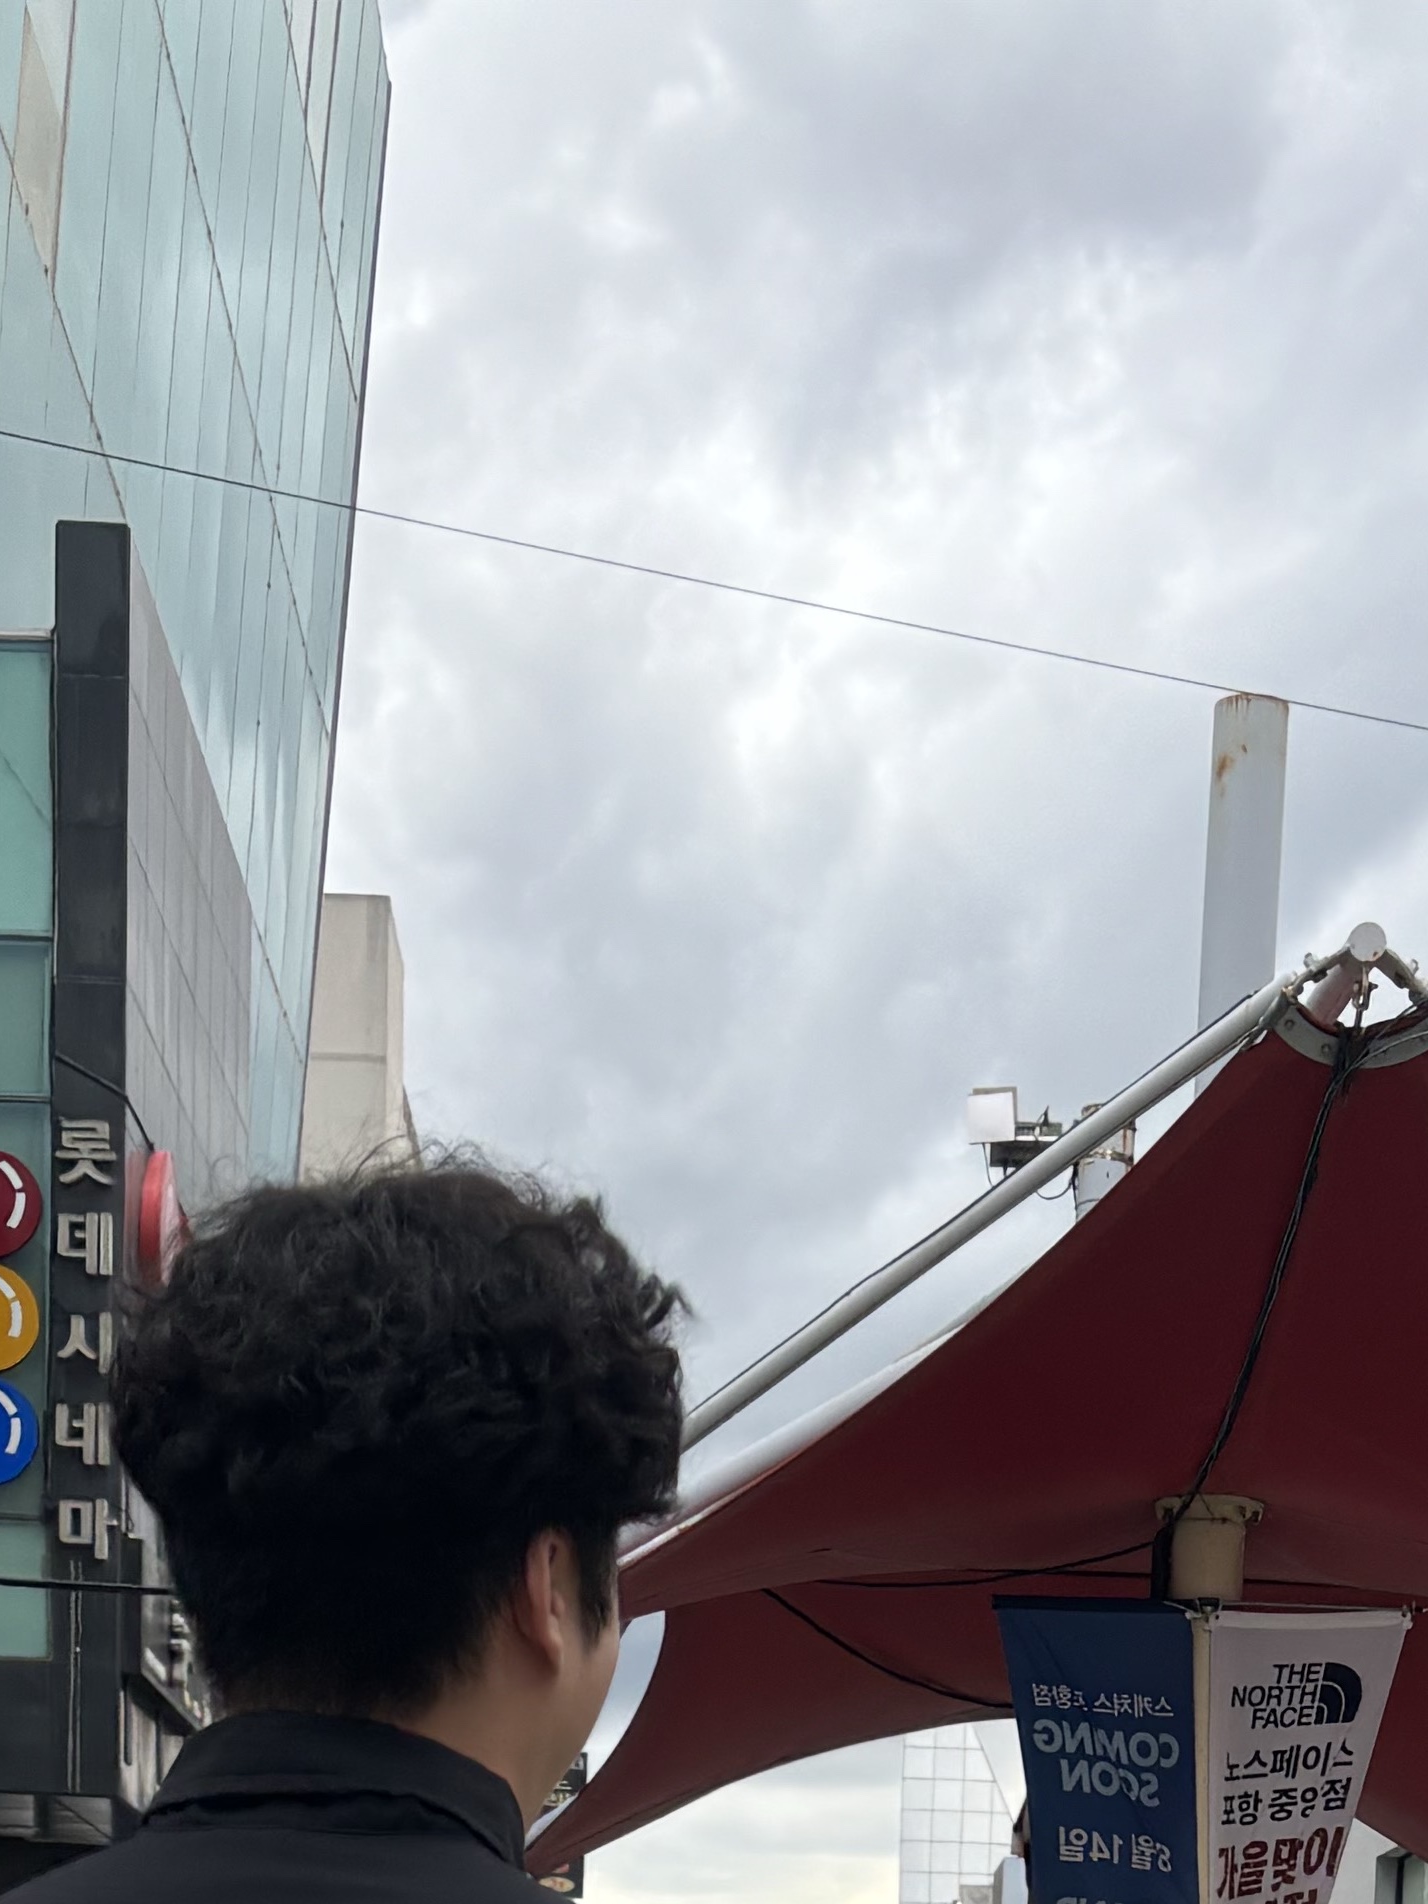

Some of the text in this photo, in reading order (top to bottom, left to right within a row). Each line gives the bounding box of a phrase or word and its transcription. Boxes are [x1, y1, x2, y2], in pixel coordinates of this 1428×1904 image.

[54, 1118, 118, 1561] 롯데시네마
[1273, 1662, 1322, 1684] THE
[1231, 1683, 1319, 1707] NORTH
[1251, 1705, 1315, 1729] FACE
[1224, 1737, 1355, 1782] 노스페이스
